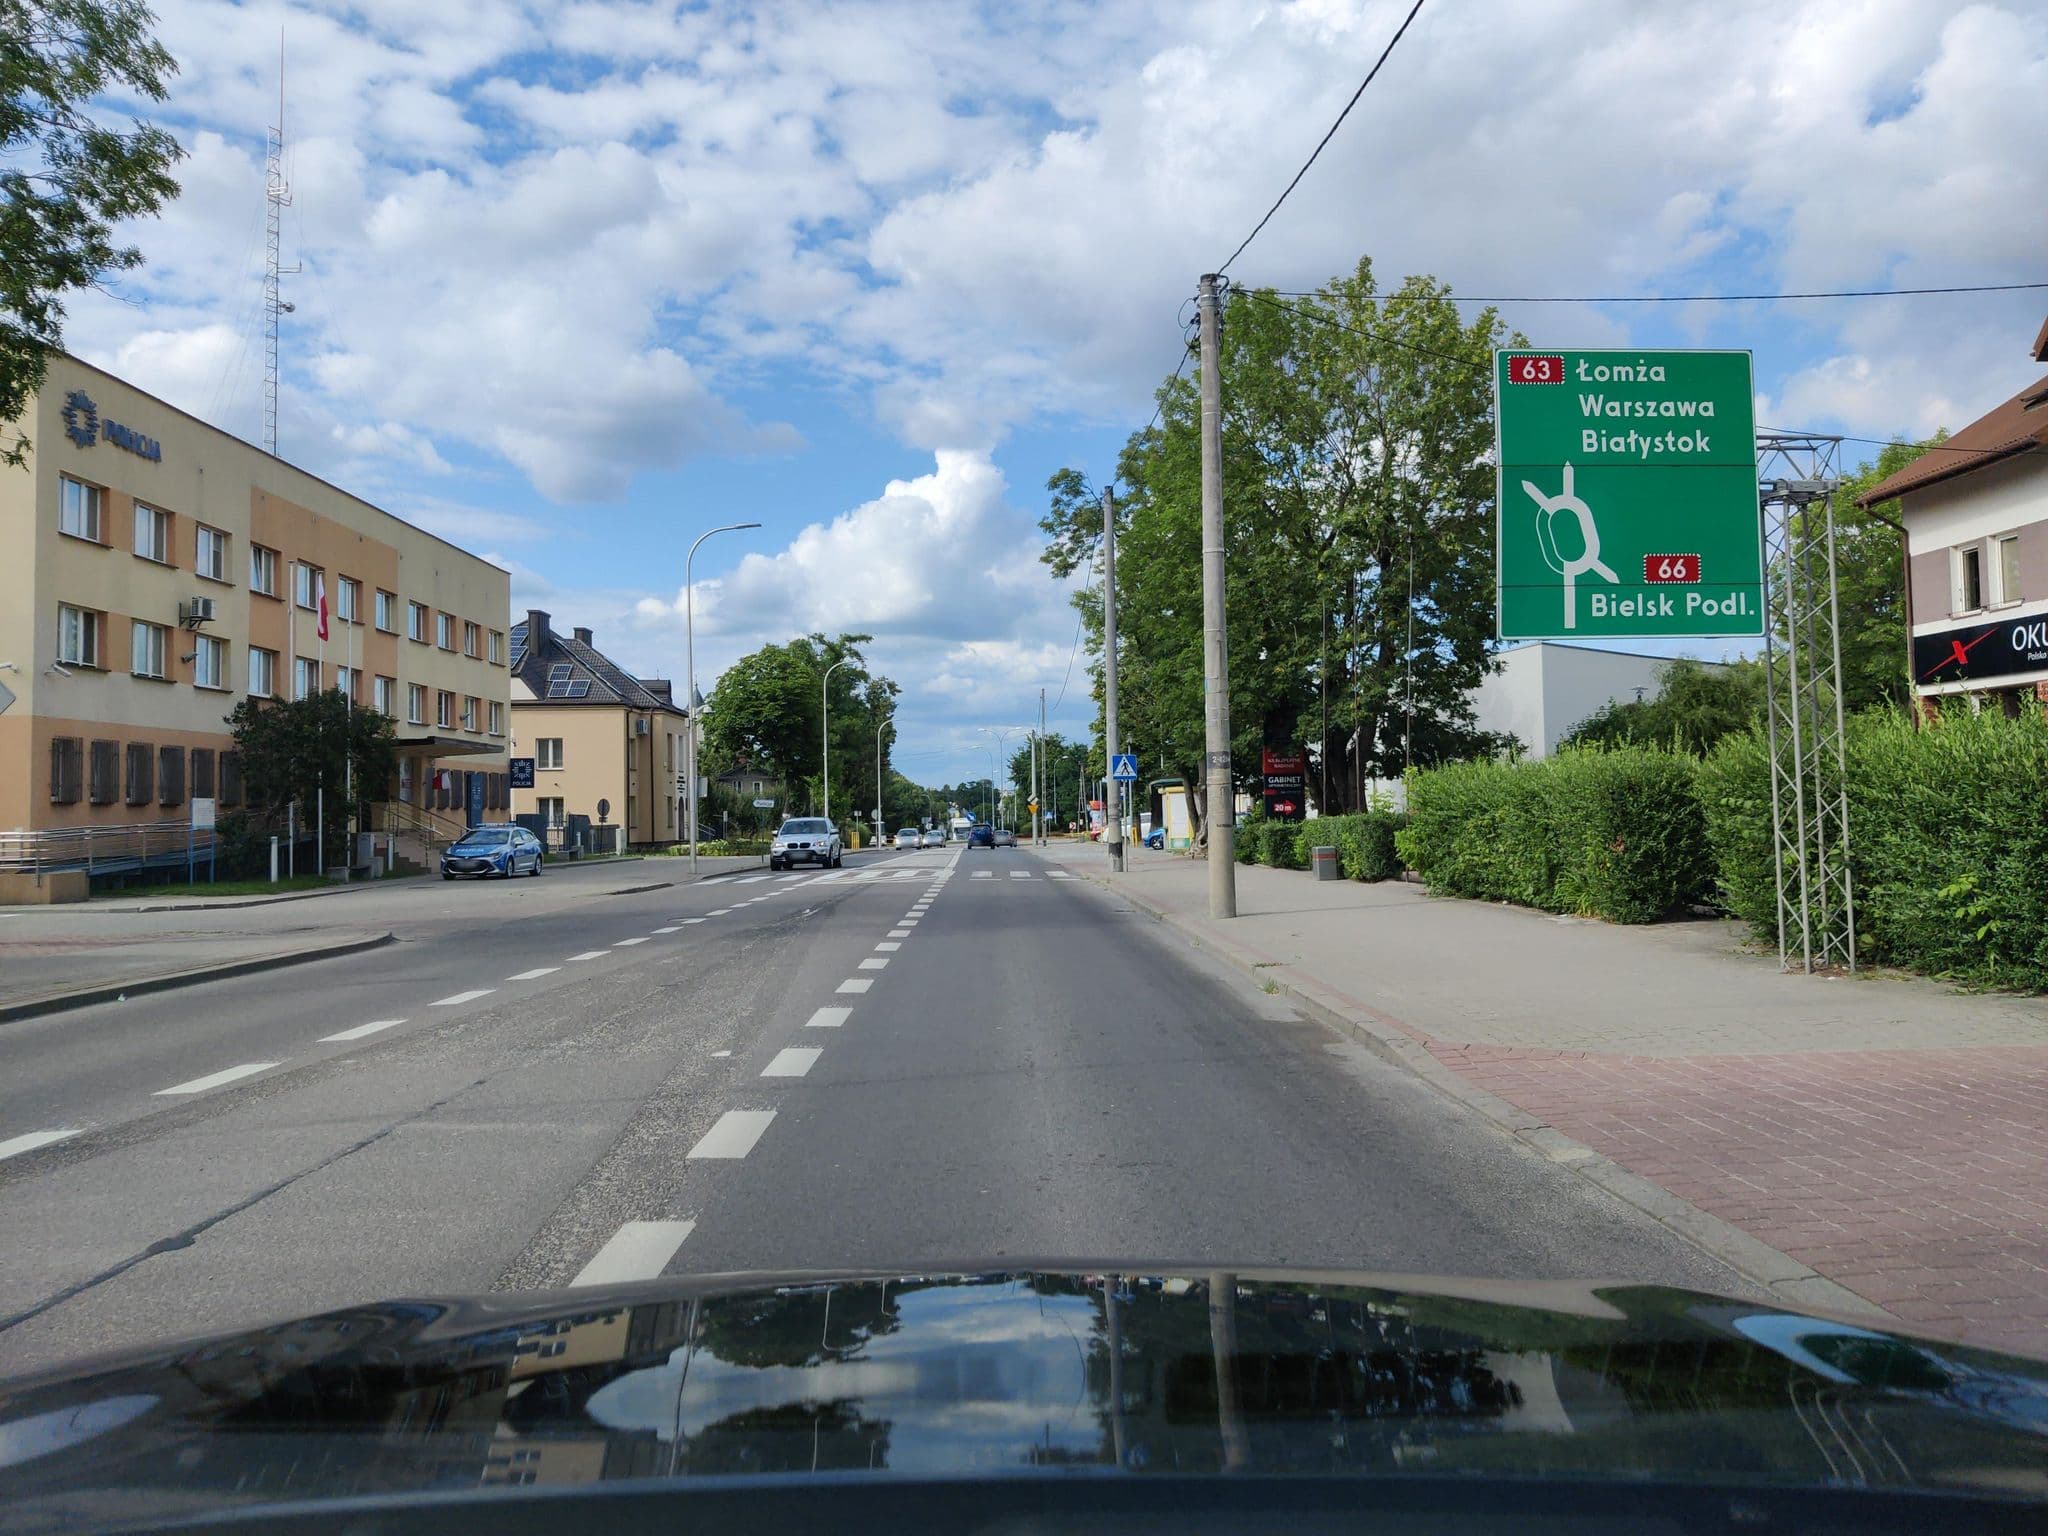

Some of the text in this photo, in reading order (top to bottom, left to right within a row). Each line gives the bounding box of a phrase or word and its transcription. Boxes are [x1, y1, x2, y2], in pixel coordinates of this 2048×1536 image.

[1522, 360, 1551, 380] 63
[1576, 359, 1666, 382] Łomża
[1578, 394, 1715, 417] Warszawa
[1581, 429, 1711, 459] Białystok
[1658, 558, 1687, 579] 66
[1591, 592, 1755, 617] Bielsk Podl.
[1268, 776, 1302, 784] GABINET
[1274, 803, 1284, 812] 20
